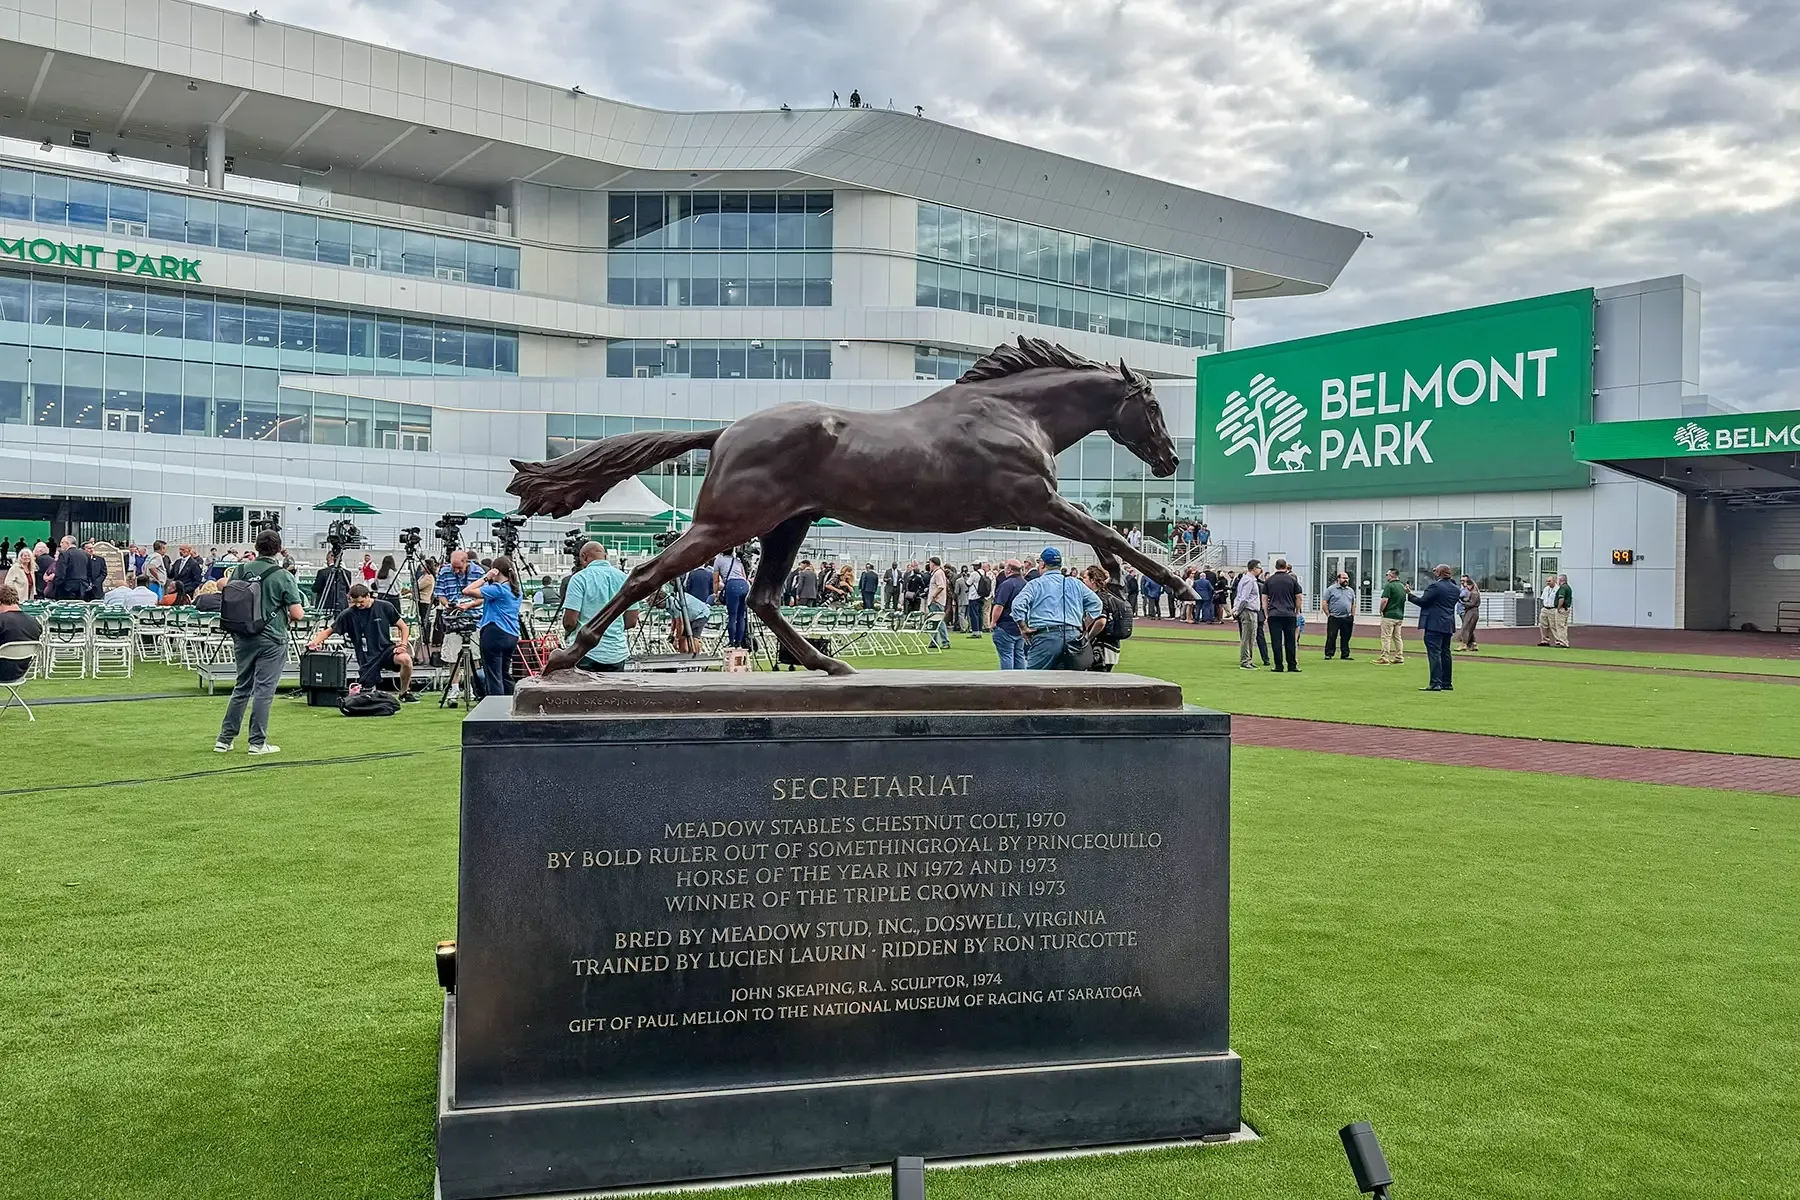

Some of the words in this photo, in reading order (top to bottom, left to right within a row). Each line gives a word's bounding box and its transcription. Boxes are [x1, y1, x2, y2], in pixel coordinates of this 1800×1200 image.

[0, 237, 104, 270] MONT
[116, 249, 202, 283] PARK
[1320, 347, 1558, 421] BELMONT
[1320, 419, 1434, 471] PARK
[1613, 551, 1629, 562] 99
[772, 775, 973, 801] SECRETARIAT
[664, 820, 765, 839] MEADOW
[770, 817, 855, 835] STABLE'S
[862, 815, 964, 832] CHESTNUT
[969, 813, 1020, 829] COLT,
[1026, 812, 1066, 827] 1970
[547, 851, 575, 869] BY
[582, 849, 641, 867] BOLD
[649, 846, 718, 864] RULER
[724, 844, 769, 861] OUT
[774, 842, 802, 860] OF
[808, 836, 992, 858] SOMETHINGROYAL
[999, 836, 1021, 851] BY
[1026, 832, 1162, 851] PRINCEQUILLO
[676, 868, 749, 887] HORSE
[755, 866, 784, 884] OF
[790, 864, 830, 882] THE
[836, 861, 890, 880] YEAR
[896, 861, 918, 877] IN
[924, 859, 964, 876] 1972
[970, 858, 1013, 875] AND
[1020, 857, 1058, 874] 1973
[664, 892, 755, 913] WINNER
[762, 890, 790, 908] OF
[797, 888, 837, 906] THE
[844, 885, 911, 904] TRIPLE
[916, 883, 994, 901] CROWN
[1000, 881, 1022, 897] IN
[1028, 880, 1066, 896] 1973
[615, 930, 672, 949] BRED
[678, 928, 706, 946] BY
[711, 922, 811, 944] MEADOW
[815, 920, 872, 938] STUD,
[877, 917, 920, 936] INC.,
[925, 913, 1021, 933] DOSWELL,
[1023, 910, 1107, 927] VIRGINIA
[572, 955, 670, 976] TRAINED
[676, 952, 703, 970] BY
[708, 948, 783, 969] LUCIEN
[790, 943, 867, 963] LAURIN
[881, 938, 958, 958] RIDDEN
[963, 937, 988, 954] BY
[993, 935, 1035, 952] RON
[1041, 930, 1138, 951] TURCOTTE
[730, 987, 773, 1003] JOHN
[777, 981, 855, 999] SKEAPING,
[858, 977, 887, 993] R.A.
[890, 974, 970, 991] SCULPTOR,
[972, 972, 1003, 986] 1974
[568, 1017, 606, 1033] GIFT
[610, 1015, 633, 1031] OF
[637, 1013, 678, 1029] PAUL
[682, 1009, 748, 1026] MELLON
[752, 1007, 774, 1021] TO
[777, 1004, 808, 1019] THE
[812, 1000, 891, 1018] NATIONAL
[895, 995, 960, 1011] MUSEUM
[963, 993, 985, 1007] OF
[987, 990, 1043, 1006] RACING
[1046, 988, 1065, 1002] AT
[1068, 985, 1142, 1001] SARATOGA
